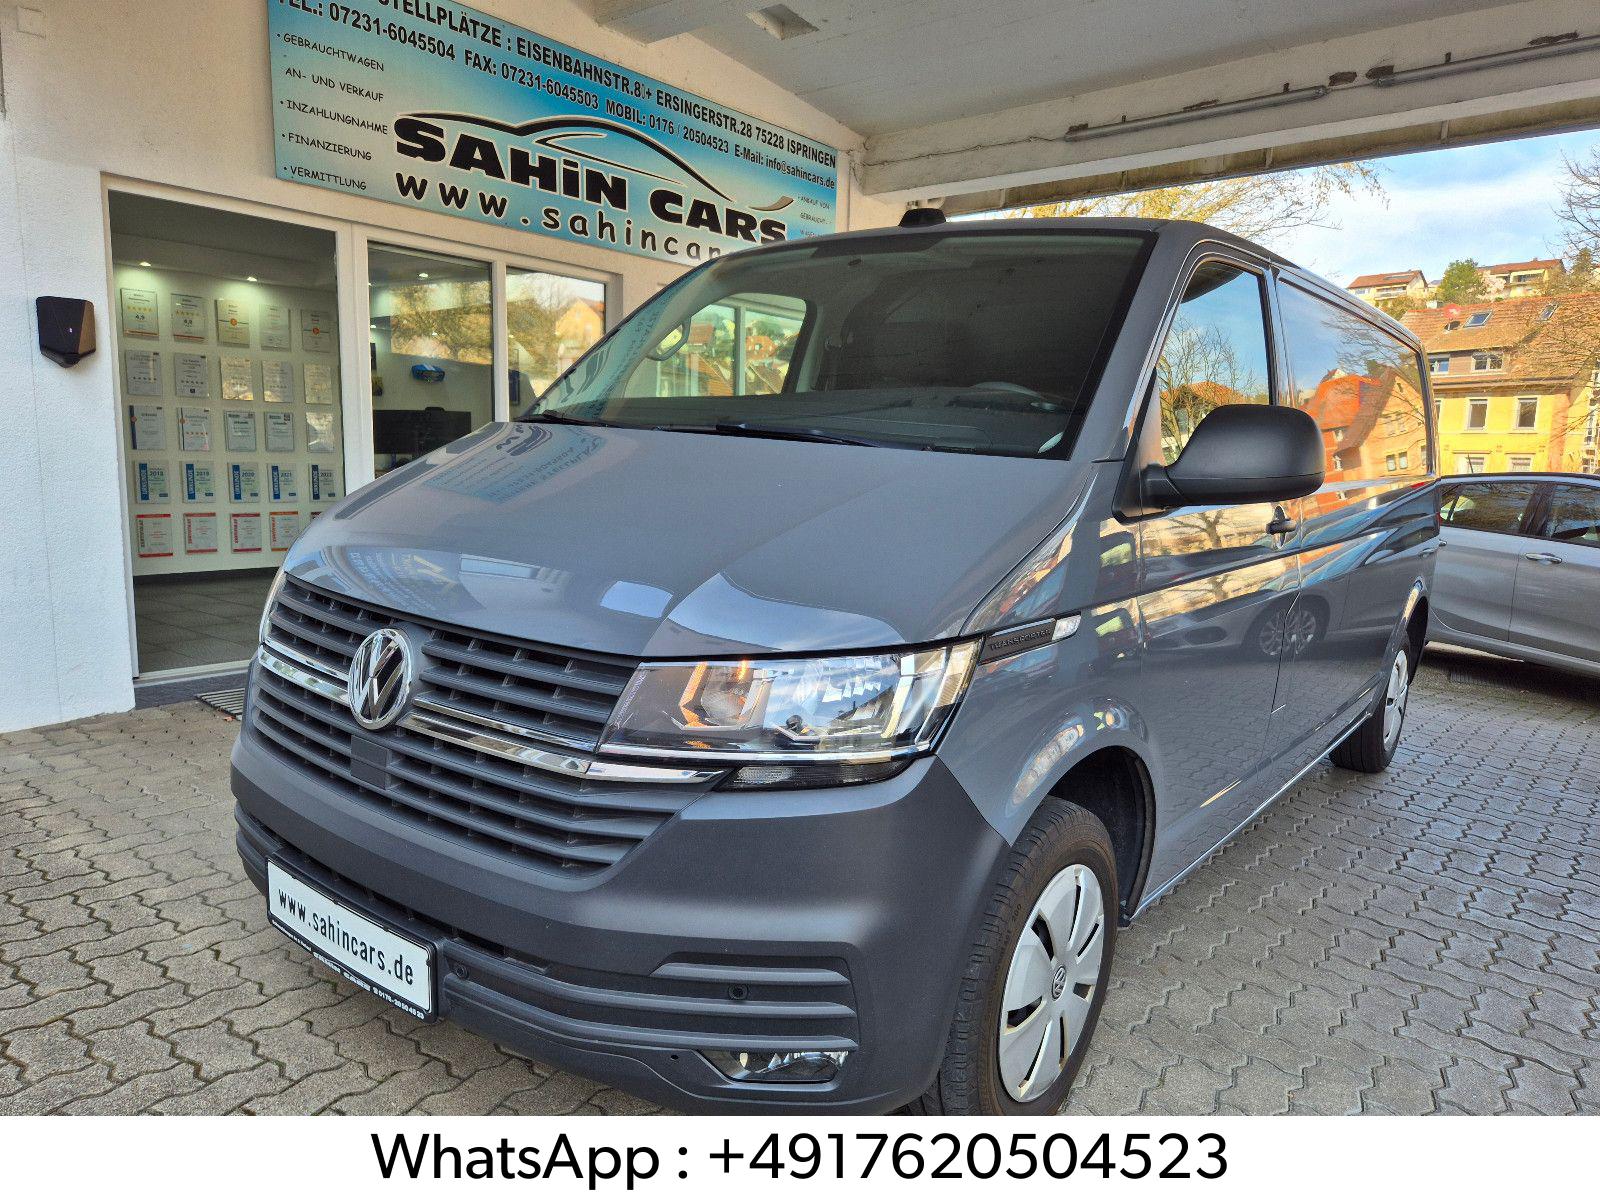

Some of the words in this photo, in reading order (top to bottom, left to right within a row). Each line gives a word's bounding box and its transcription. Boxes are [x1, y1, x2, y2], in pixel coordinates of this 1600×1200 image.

[283, 33, 385, 72] GEBRAUCHTWAGEN
[285, 67, 307, 80] AN-
[311, 74, 336, 89] UND
[339, 82, 385, 103] VERKAUF
[329, 2, 456, 61] 07231-6045504
[464, 49, 497, 75] FAX:
[501, 62, 599, 110] 07231-6045503
[606, 99, 646, 126] MOBIL:
[649, 114, 675, 135] 0176
[683, 125, 729, 154] 20504523
[734, 143, 764, 166] E-Mail:
[766, 154, 835, 189] info@sahincars.de
[286, 99, 388, 135] INZAHLUNGNAHME
[656, 89, 752, 139] ERSINGERSTR.28
[755, 126, 785, 150] 75228
[787, 137, 836, 169] ISPRINGEN
[288, 132, 372, 161] FINANZIERUNG
[290, 165, 367, 191] VERMITTLUNG
[650, 189, 786, 244] CARS
[278, 888, 414, 986] www.sahincars.de
